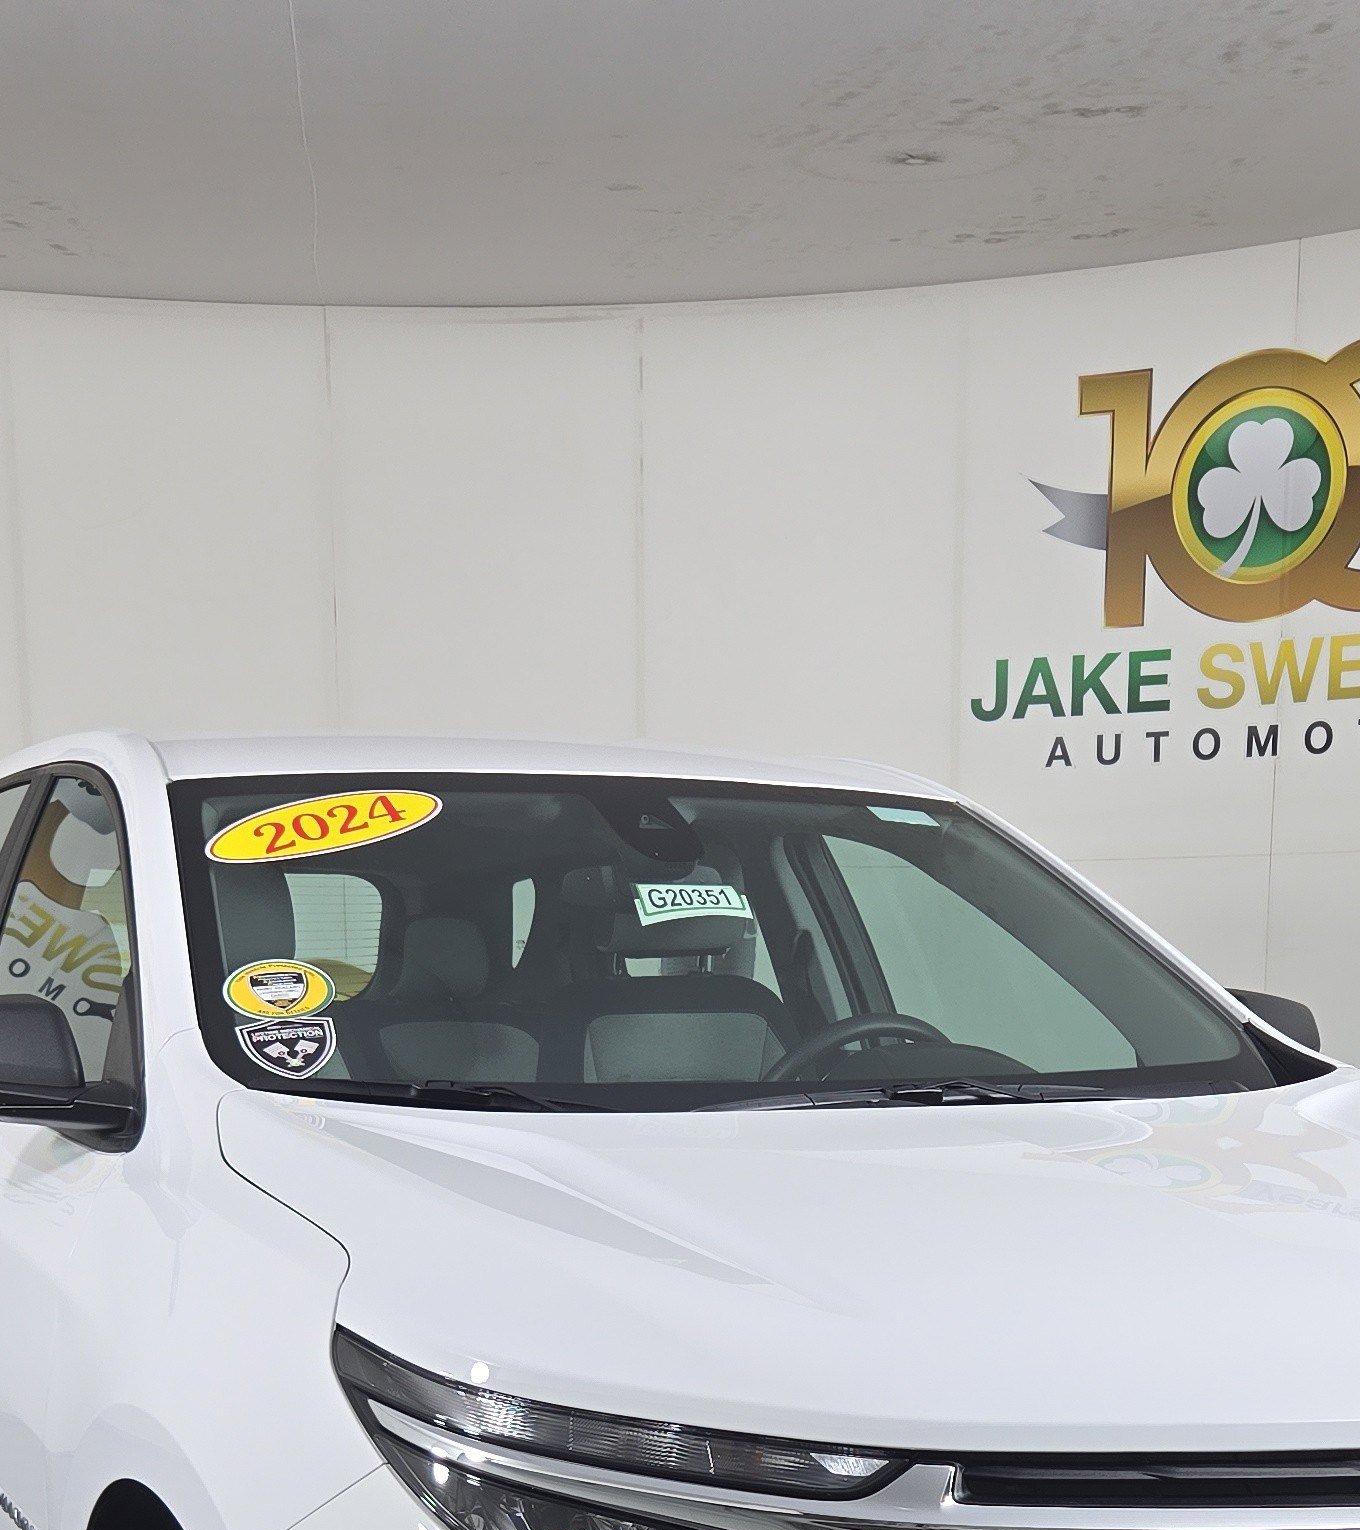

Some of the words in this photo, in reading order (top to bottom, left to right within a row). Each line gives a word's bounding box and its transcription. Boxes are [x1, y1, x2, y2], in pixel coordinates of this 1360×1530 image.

[971, 648, 1172, 722] JAKE
[253, 794, 408, 855] 2024
[647, 888, 733, 909] G20351
[252, 1028, 324, 1044] PROTECTION
